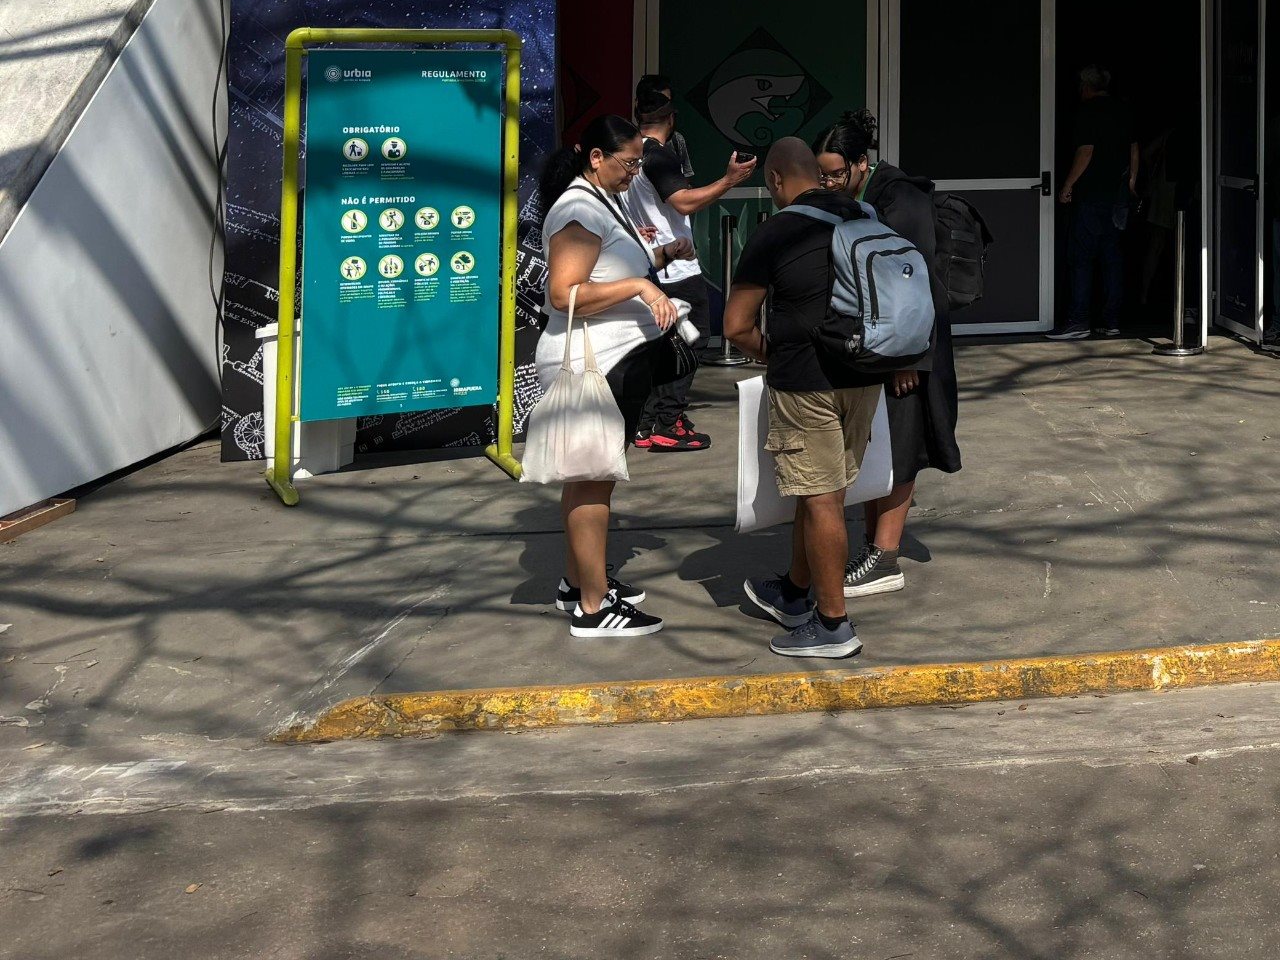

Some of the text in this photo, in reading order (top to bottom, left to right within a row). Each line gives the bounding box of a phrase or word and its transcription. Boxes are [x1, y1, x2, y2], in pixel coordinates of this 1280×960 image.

[343, 68, 372, 78] urbia
[421, 70, 487, 78] REGULAMENTO
[342, 124, 400, 134] OBRIGATÓRIO
[341, 196, 416, 205] NÃO É PERMITIDO
